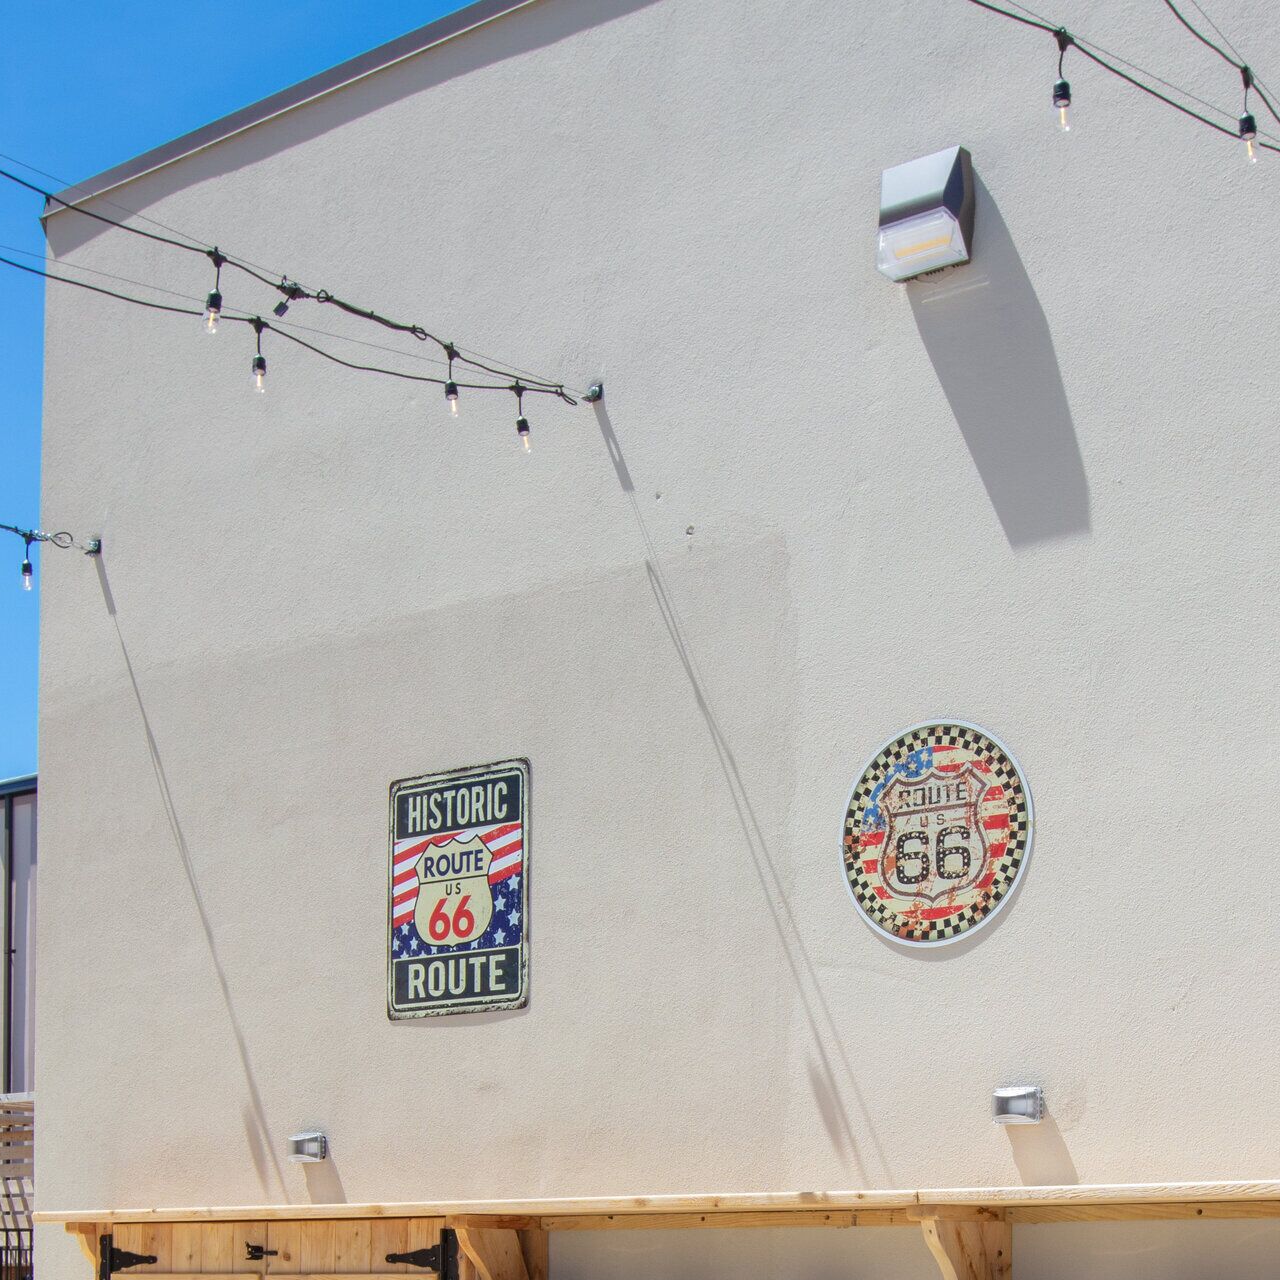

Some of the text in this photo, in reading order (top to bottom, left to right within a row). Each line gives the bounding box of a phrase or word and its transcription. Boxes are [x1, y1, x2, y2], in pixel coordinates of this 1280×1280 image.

[407, 781, 508, 834] HISTORIC
[898, 781, 968, 810] ROUTE
[919, 813, 946, 828] US
[423, 848, 484, 879] ROUTE
[895, 825, 971, 885] 66
[444, 882, 462, 897] US
[428, 894, 475, 942] 66
[407, 954, 507, 1000] ROUTE
